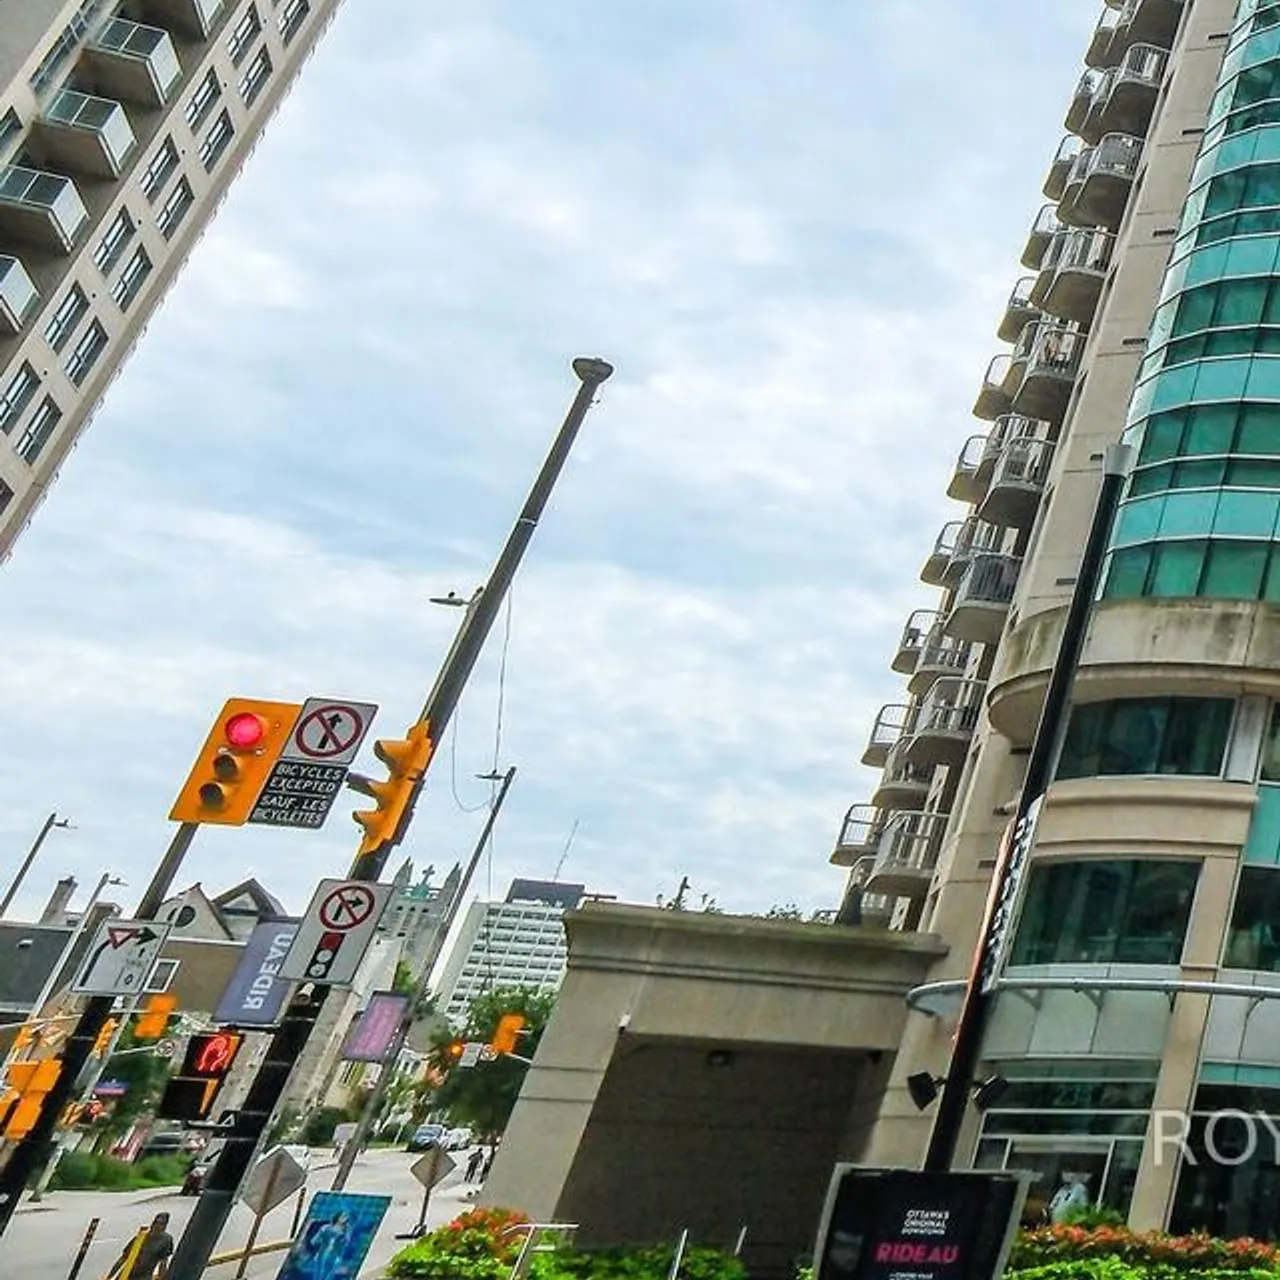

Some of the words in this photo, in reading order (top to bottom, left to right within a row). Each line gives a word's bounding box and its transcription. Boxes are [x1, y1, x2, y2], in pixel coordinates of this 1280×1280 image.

[275, 763, 342, 780] BICYCLES
[268, 776, 336, 793] EXCEPTED
[875, 1241, 960, 1265] RIDEAU
